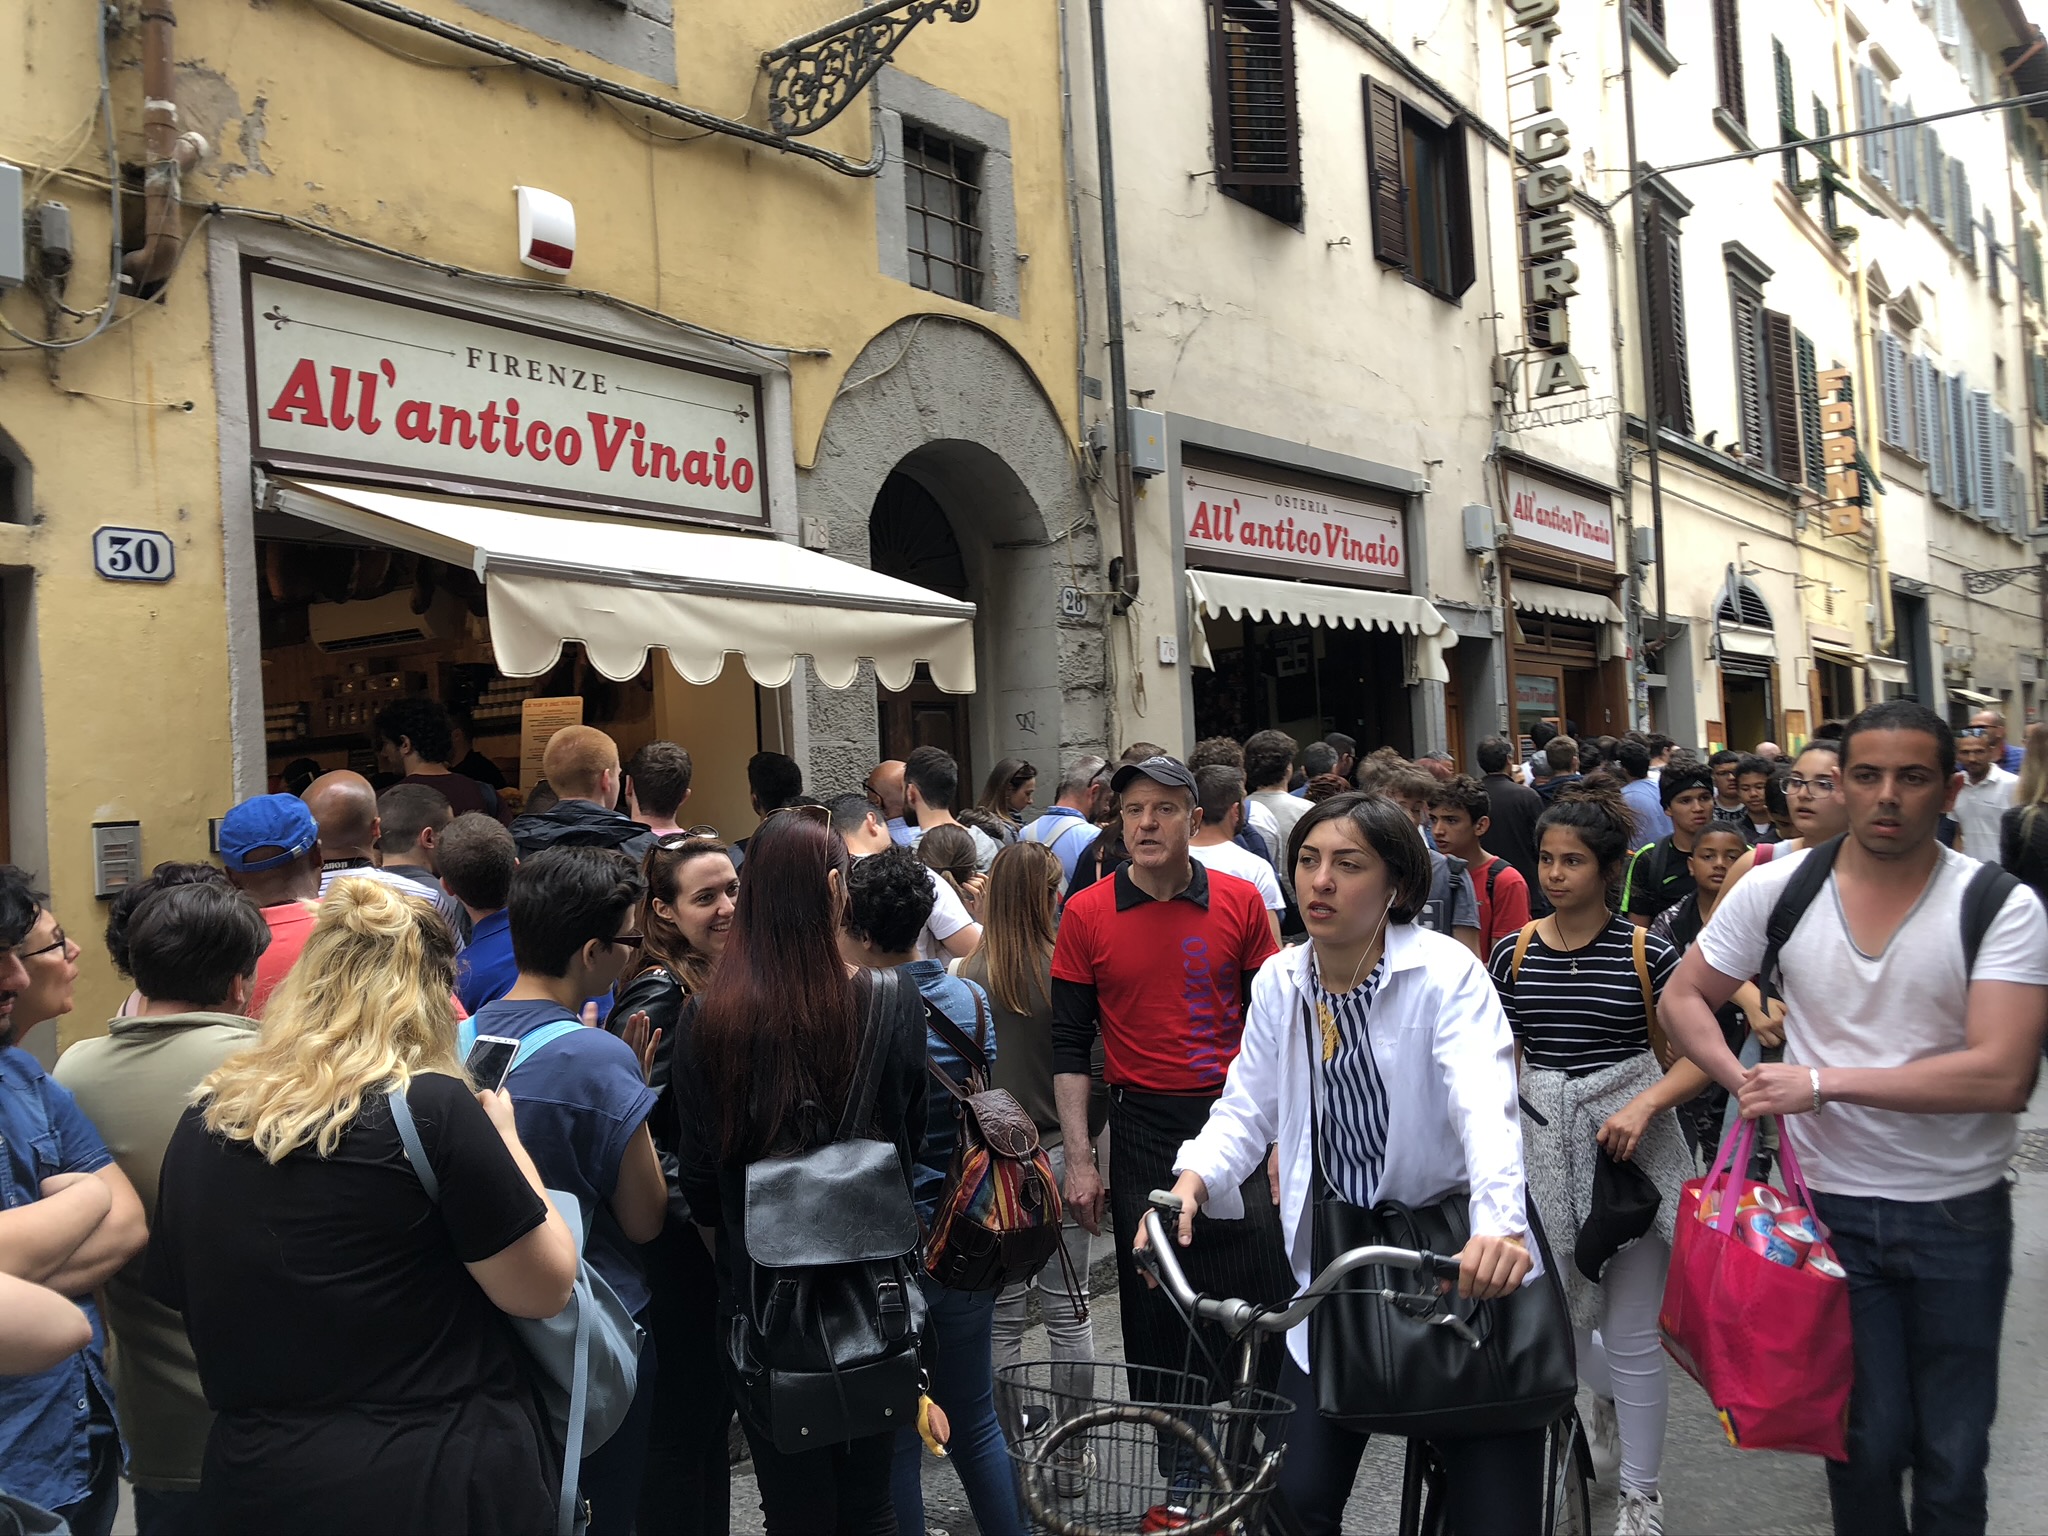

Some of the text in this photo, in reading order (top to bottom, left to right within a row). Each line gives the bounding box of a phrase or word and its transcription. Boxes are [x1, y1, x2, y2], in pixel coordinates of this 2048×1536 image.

[466, 346, 608, 395] FIRENZE
[268, 357, 754, 493] All'antico Vinaio
[1817, 367, 1863, 535] FORNO
[1274, 494, 1329, 515] OSTERIA
[1189, 497, 1400, 567] All'antico Vinaio
[1572, 510, 1610, 545] Vinaio
[108, 536, 160, 574] 30
[1064, 590, 1084, 613] 28
[323, 861, 348, 870] anon
